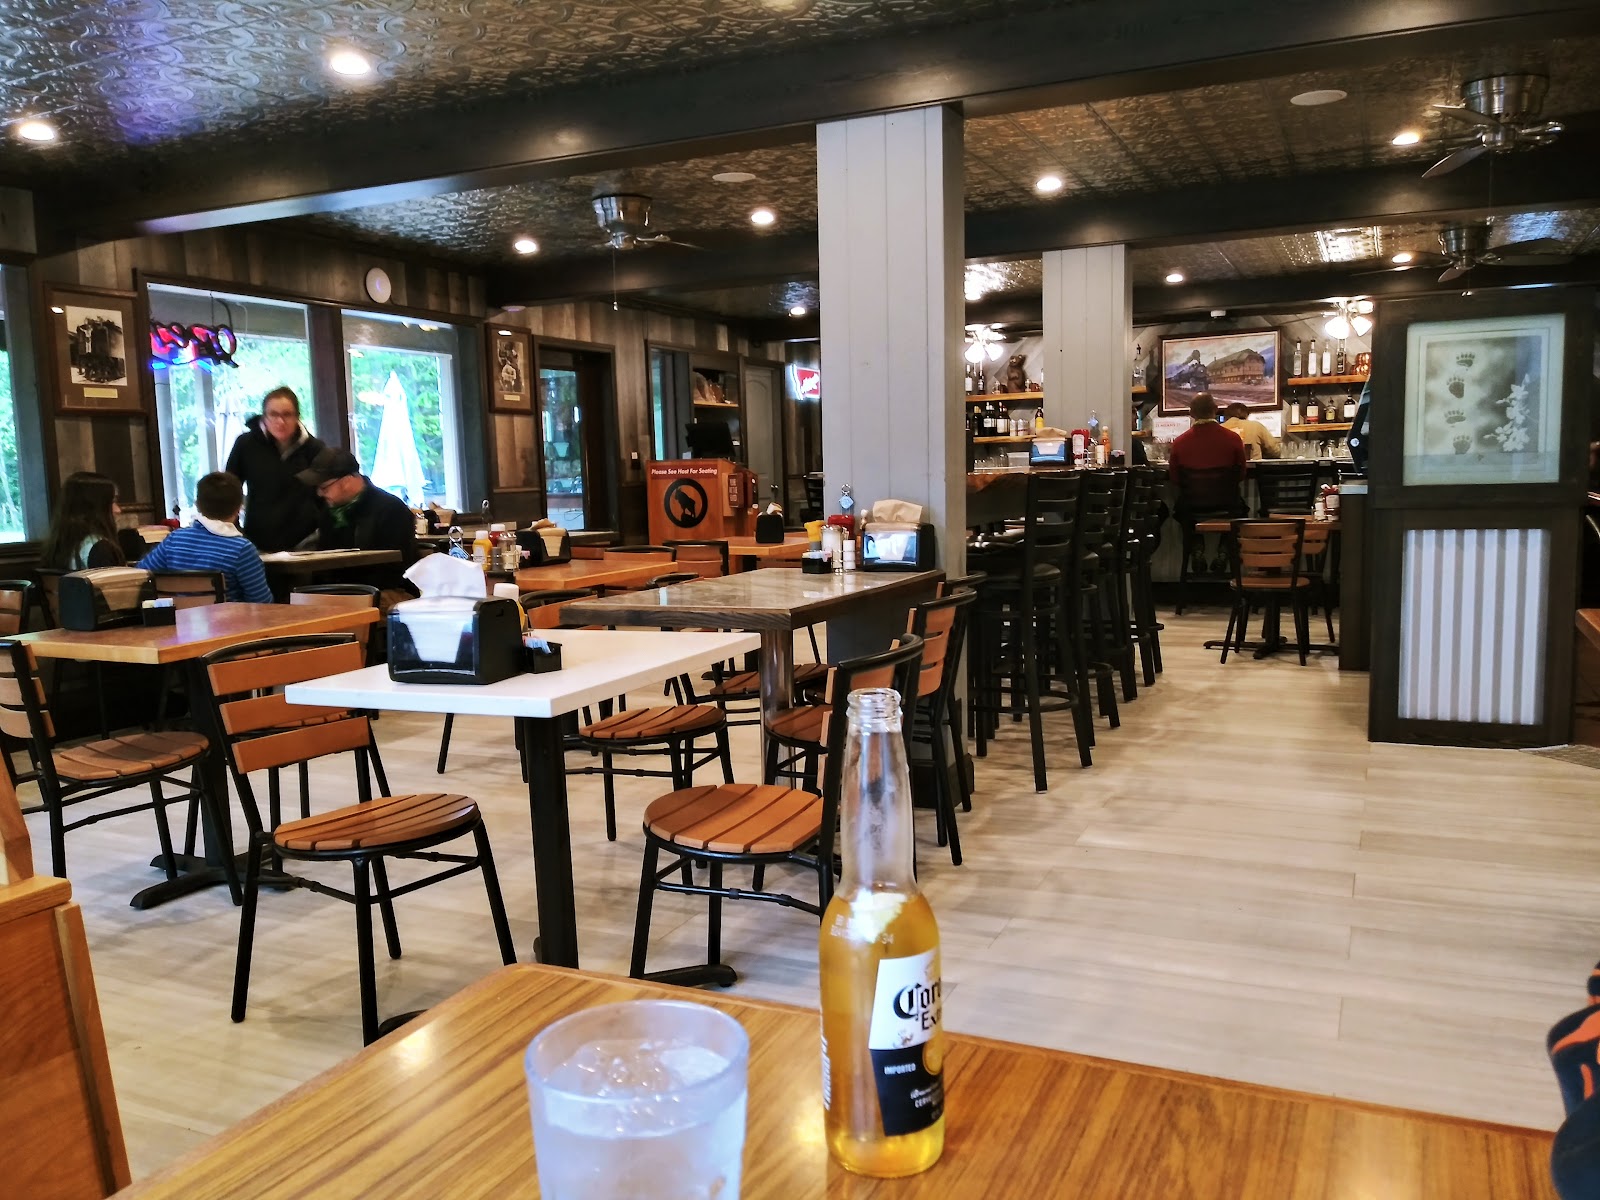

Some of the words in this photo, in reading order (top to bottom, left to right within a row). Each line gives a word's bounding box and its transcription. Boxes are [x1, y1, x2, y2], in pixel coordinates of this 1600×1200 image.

[698, 467, 718, 475] Seating
[893, 980, 941, 1021] Cor
[884, 1062, 917, 1075] IMPORTED
